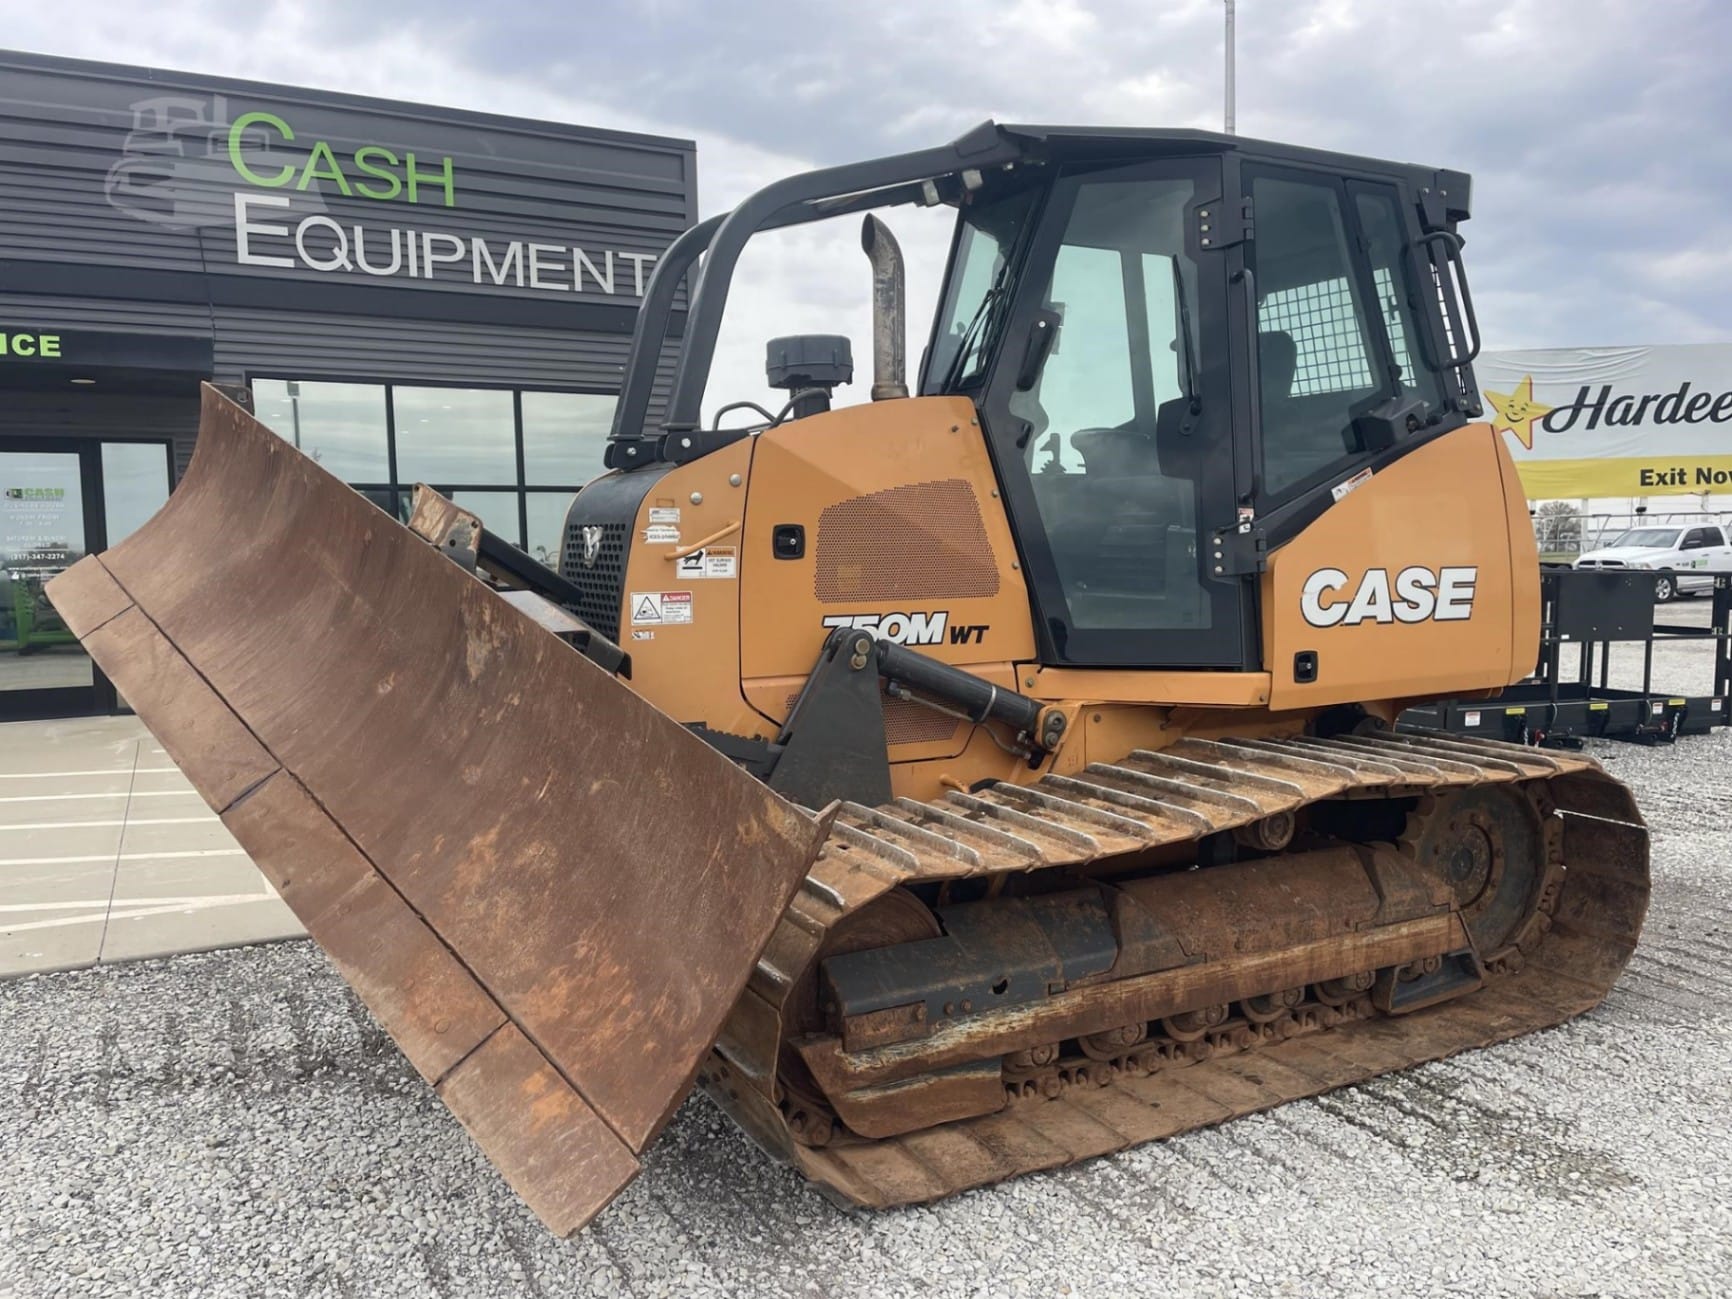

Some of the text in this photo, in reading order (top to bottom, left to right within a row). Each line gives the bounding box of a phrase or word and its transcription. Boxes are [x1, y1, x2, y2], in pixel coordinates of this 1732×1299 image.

[228, 111, 455, 207] CASH
[234, 192, 658, 297] EQUIPMENT
[1542, 381, 1732, 434] Hardee
[1639, 466, 1732, 487] Exit No
[1301, 566, 1479, 628] CASE
[950, 624, 990, 645] WT
